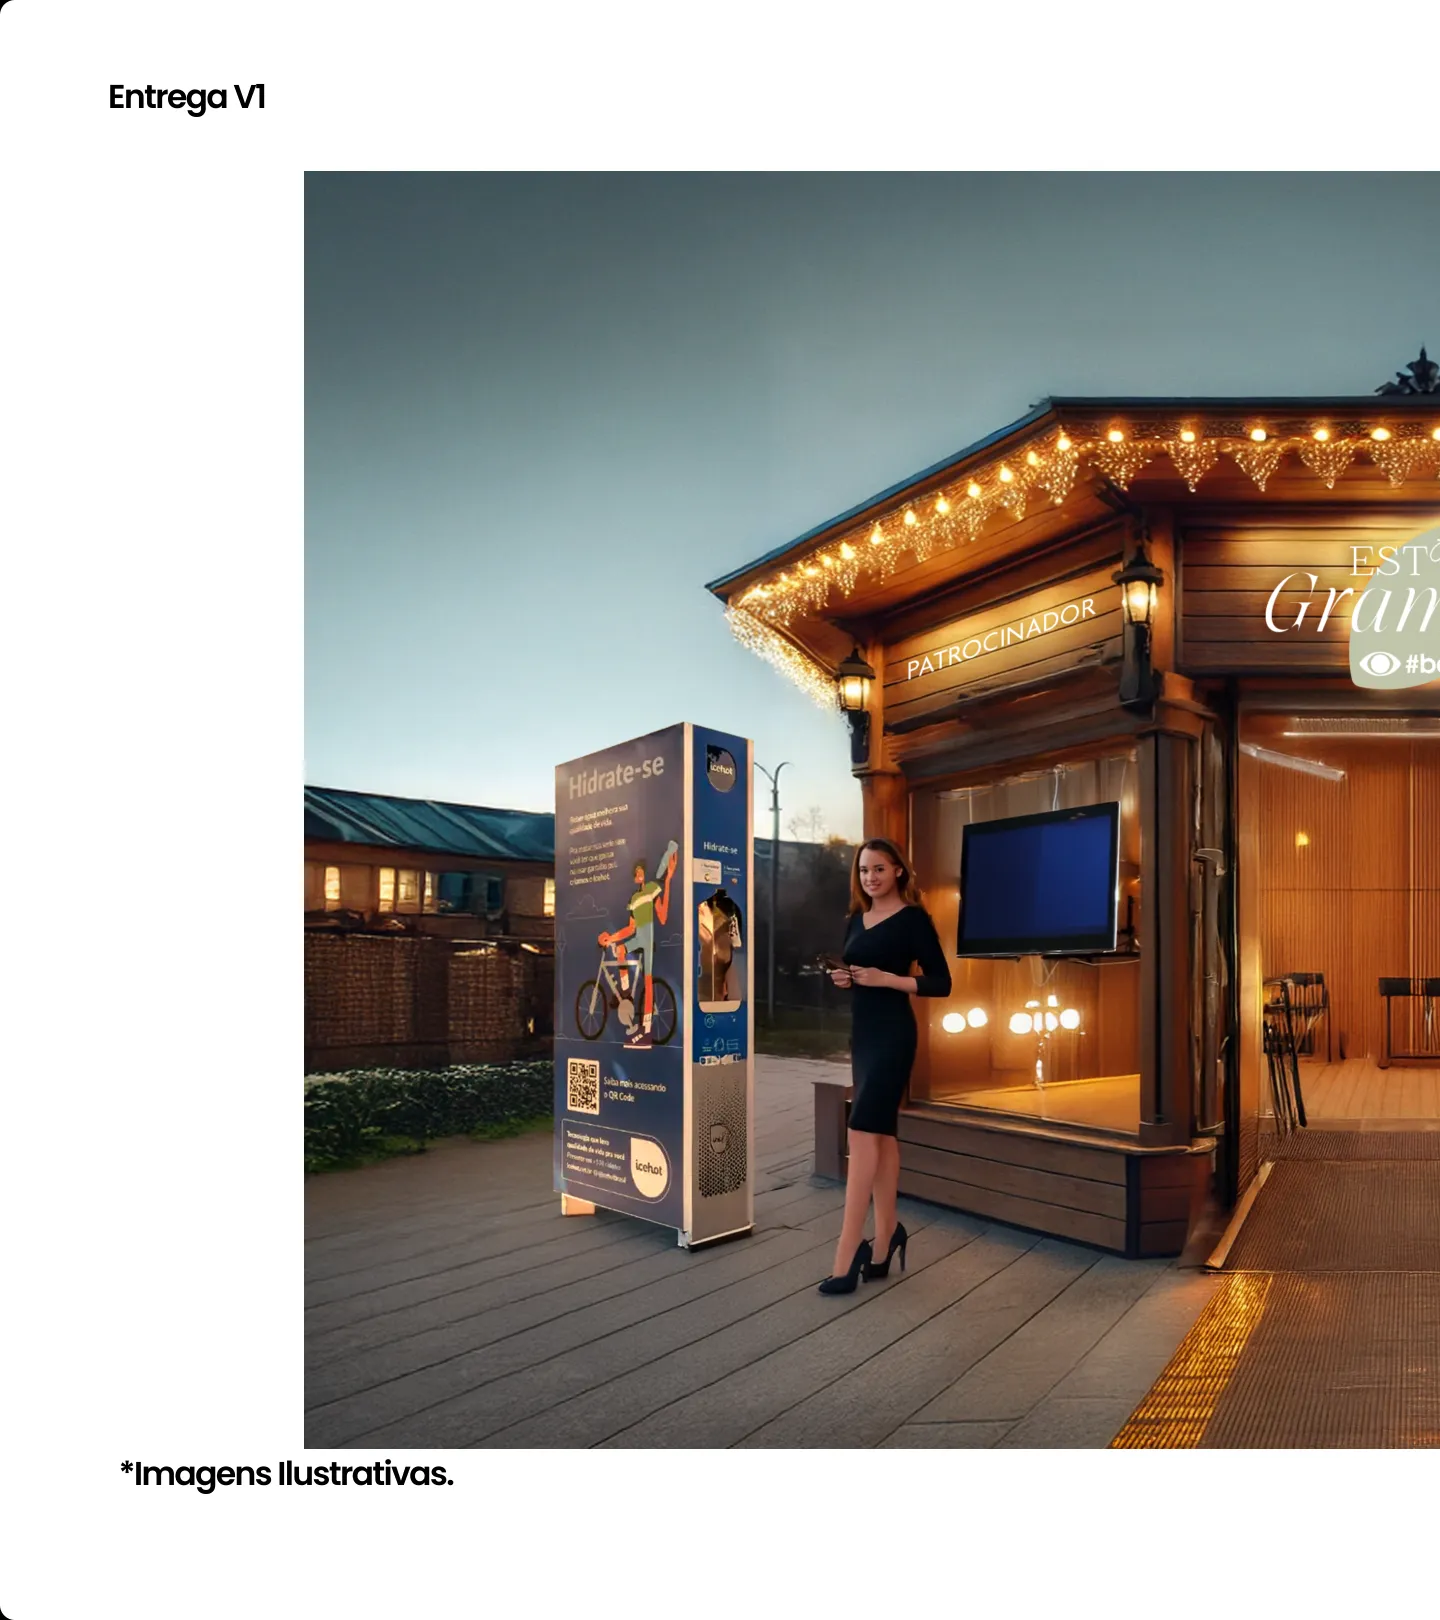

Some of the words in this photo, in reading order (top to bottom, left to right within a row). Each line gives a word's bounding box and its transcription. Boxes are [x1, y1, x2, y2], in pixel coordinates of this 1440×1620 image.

[908, 598, 1096, 680] PATROCINADOR
[569, 756, 664, 800] Hidrate-se
[704, 841, 738, 854] Hidrate-se
[604, 1076, 618, 1086] Saiba
[620, 1079, 633, 1088] mais
[634, 1081, 667, 1092] acessando
[609, 1090, 618, 1101] QR
[619, 1092, 635, 1102] Code
[635, 1159, 663, 1176] icehot
